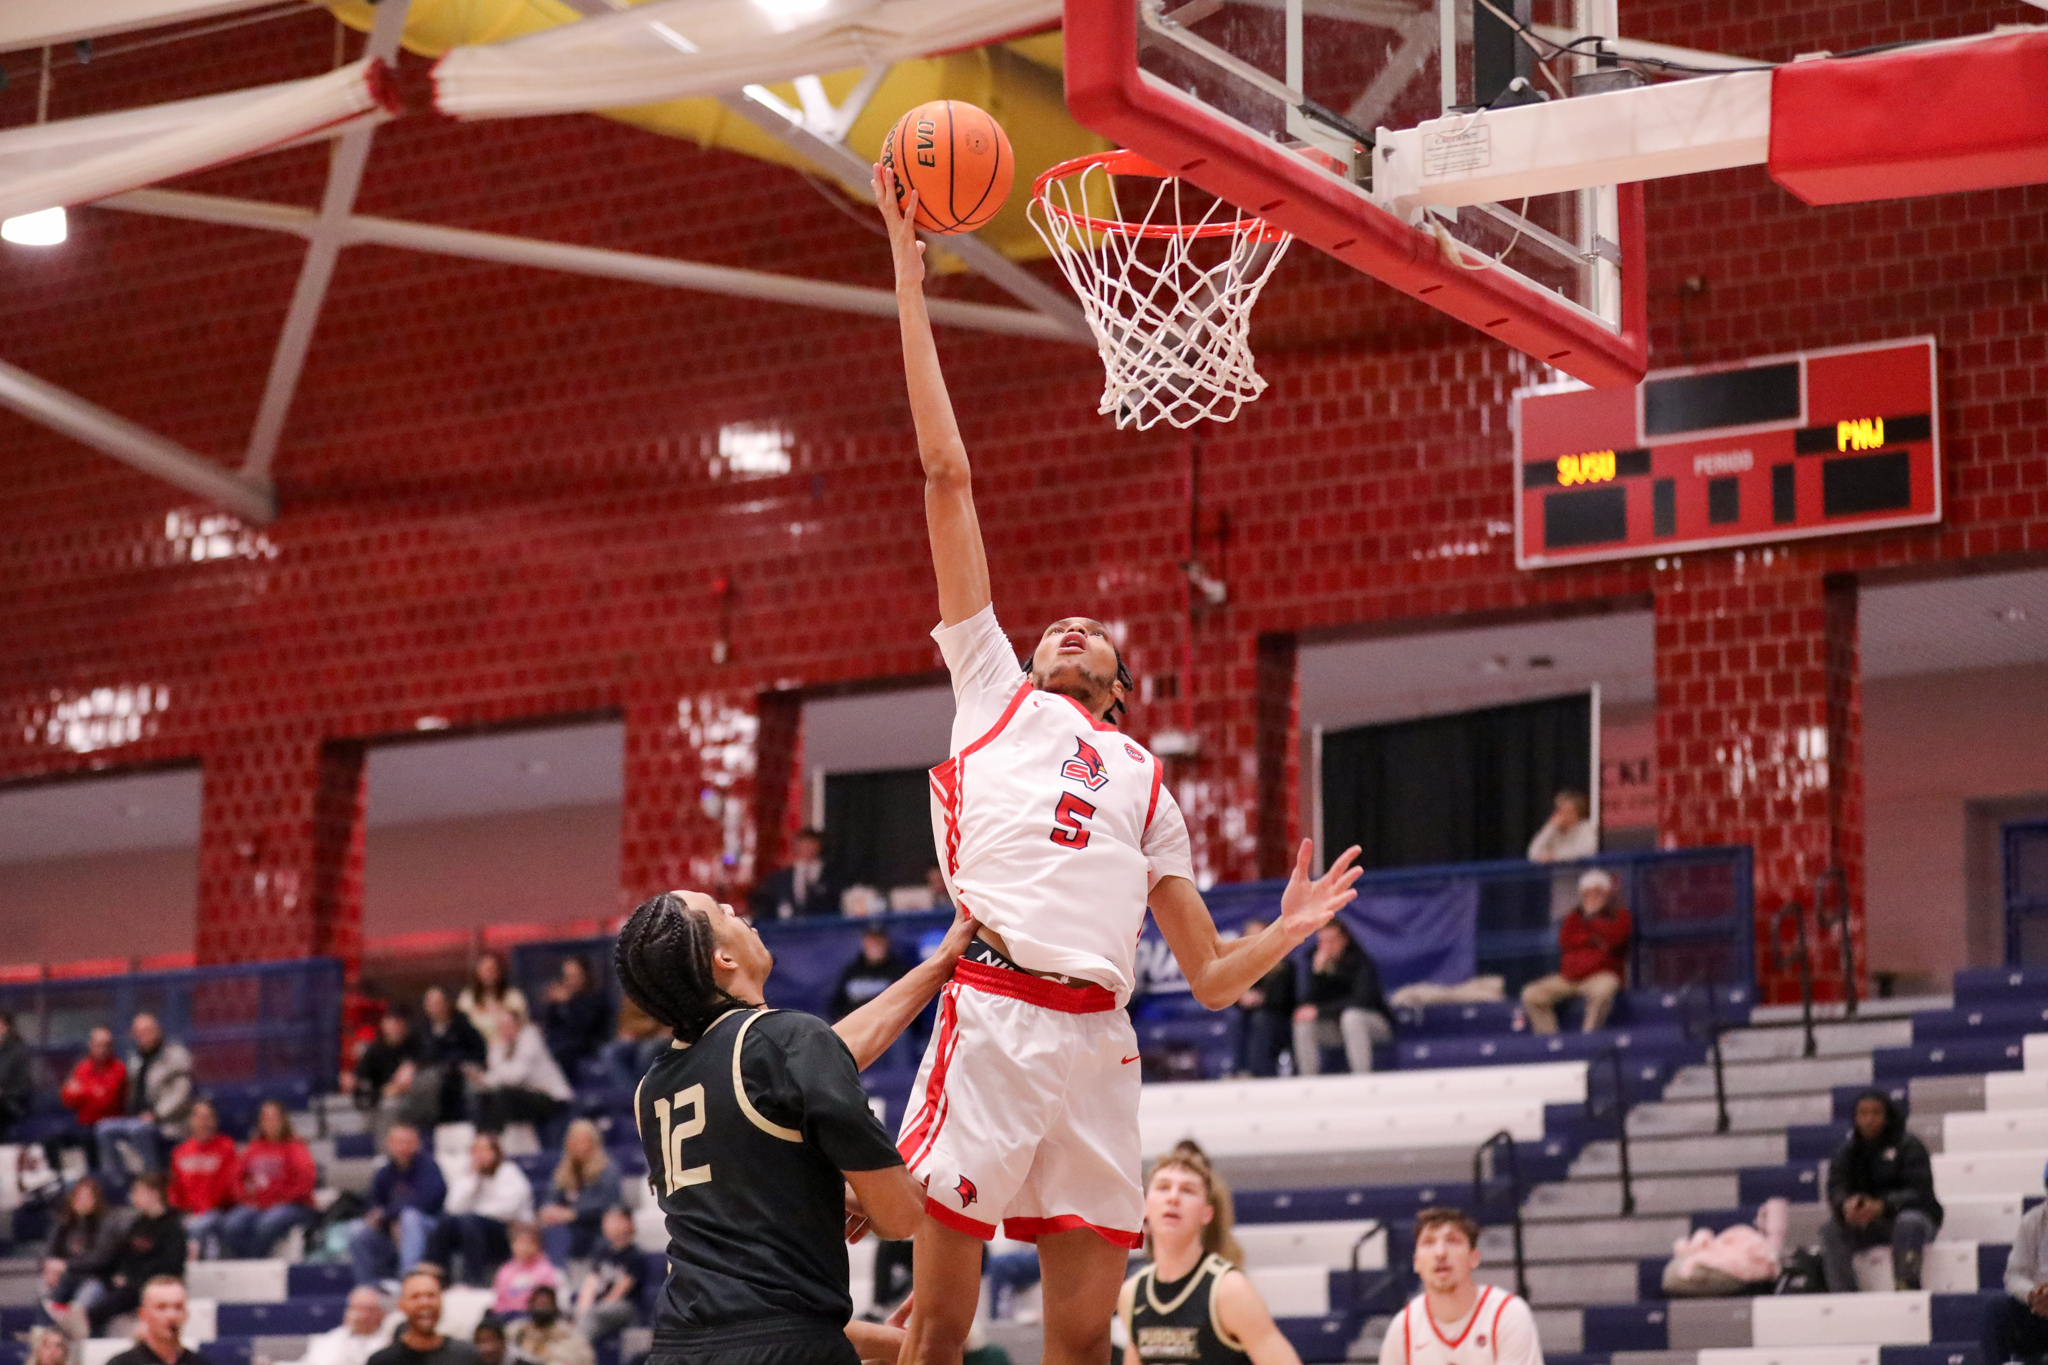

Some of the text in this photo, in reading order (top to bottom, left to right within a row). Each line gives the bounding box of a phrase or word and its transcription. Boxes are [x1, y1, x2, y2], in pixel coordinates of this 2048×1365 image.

[916, 120, 936, 168] EVO
[1837, 416, 1885, 453] PNW
[1062, 762, 1106, 789] SV
[1049, 790, 1097, 850] 5
[653, 1082, 712, 1198] 12
